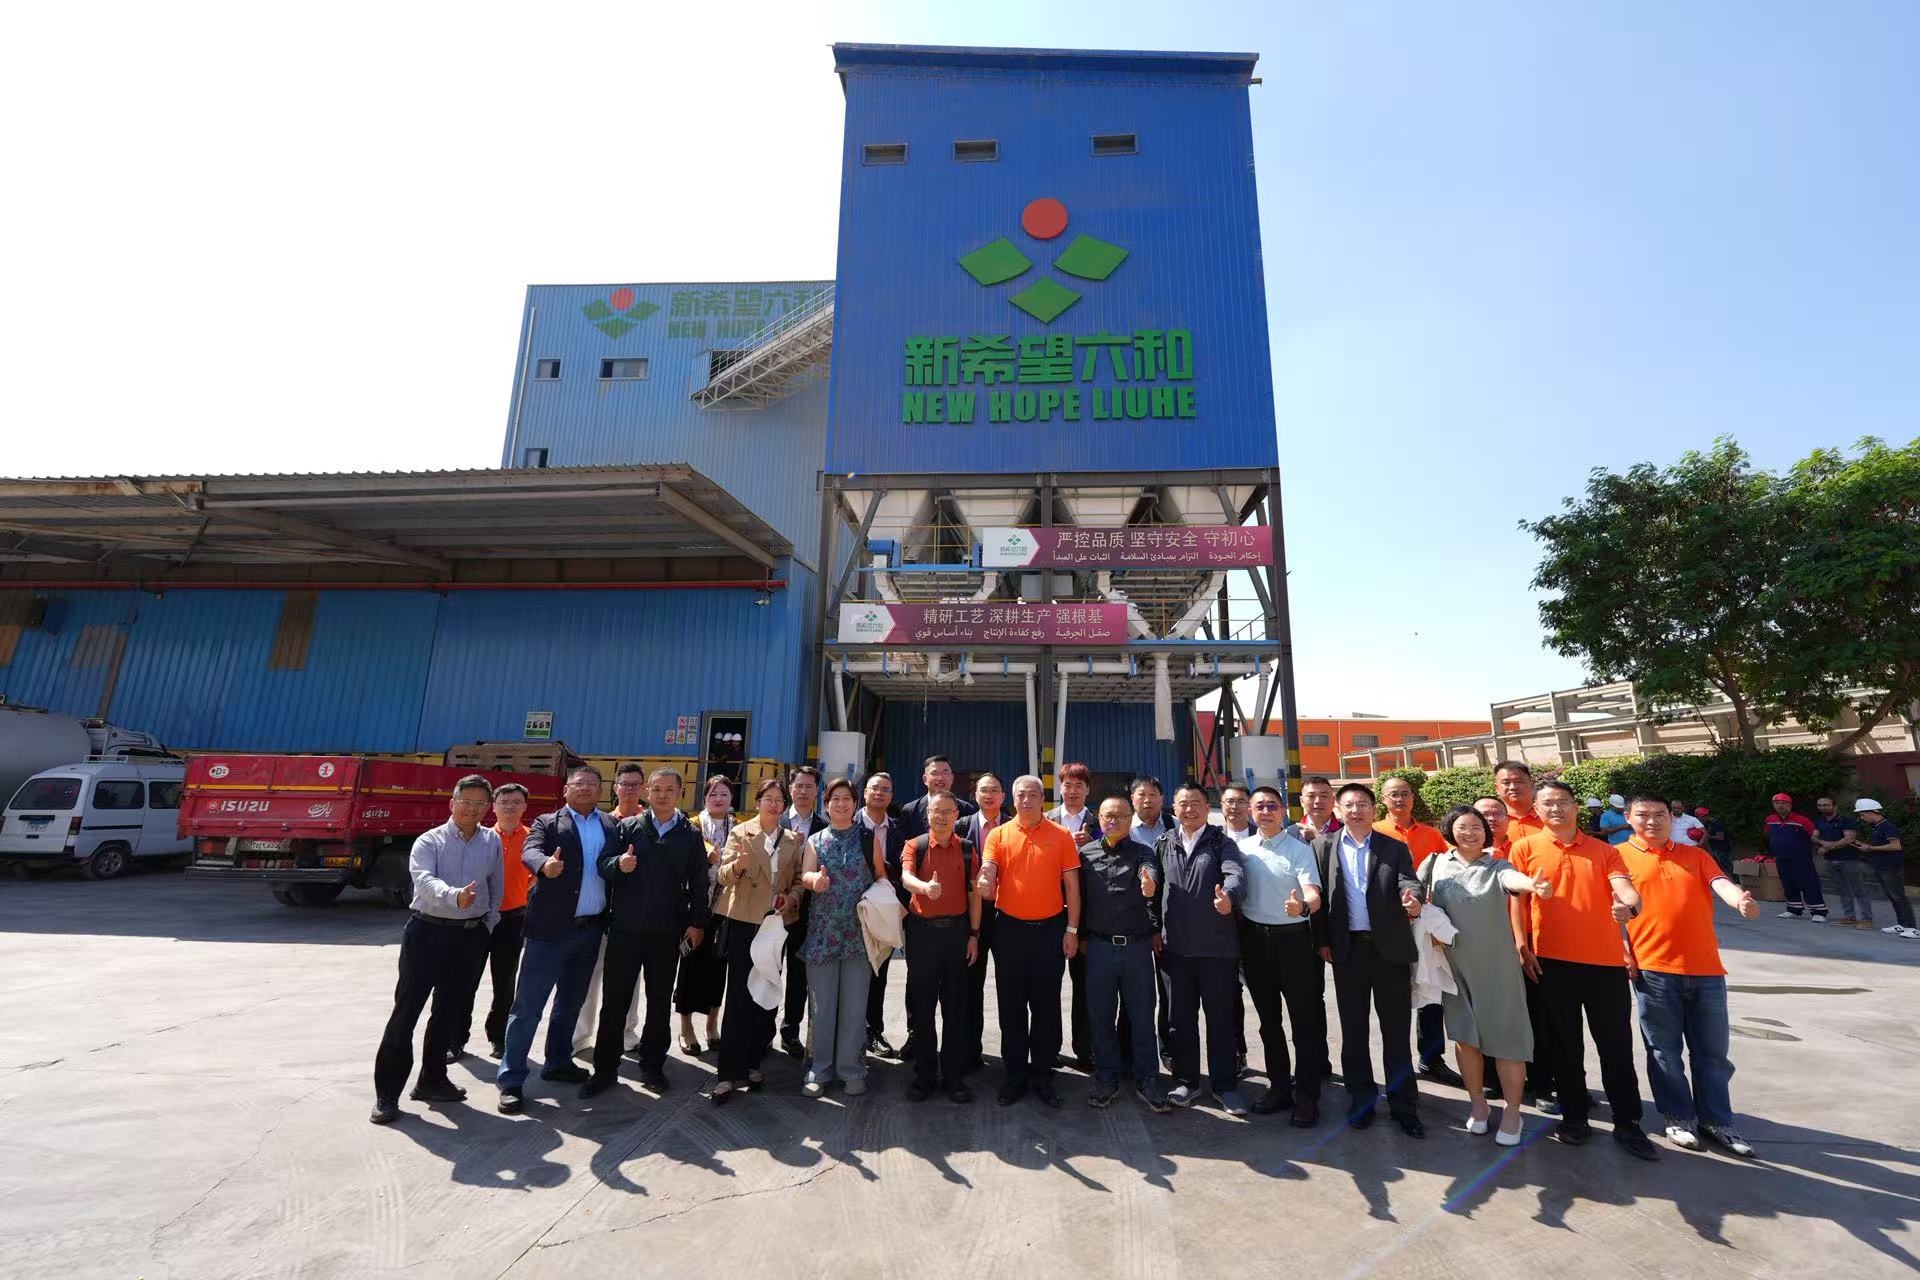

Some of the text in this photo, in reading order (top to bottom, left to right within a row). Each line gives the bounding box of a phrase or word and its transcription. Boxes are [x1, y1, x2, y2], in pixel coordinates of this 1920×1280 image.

[669, 320, 707, 338] NEW
[904, 329, 1193, 385] 新希望六和
[902, 386, 1197, 423] NEW HOPE LIUHE
[1057, 530, 1256, 548] 严控品质 坚守安全 守初心
[923, 608, 1103, 624] 精研工艺 深耕生产 强根基
[221, 800, 270, 812] ISUZU
[362, 809, 390, 818] ISUZU
